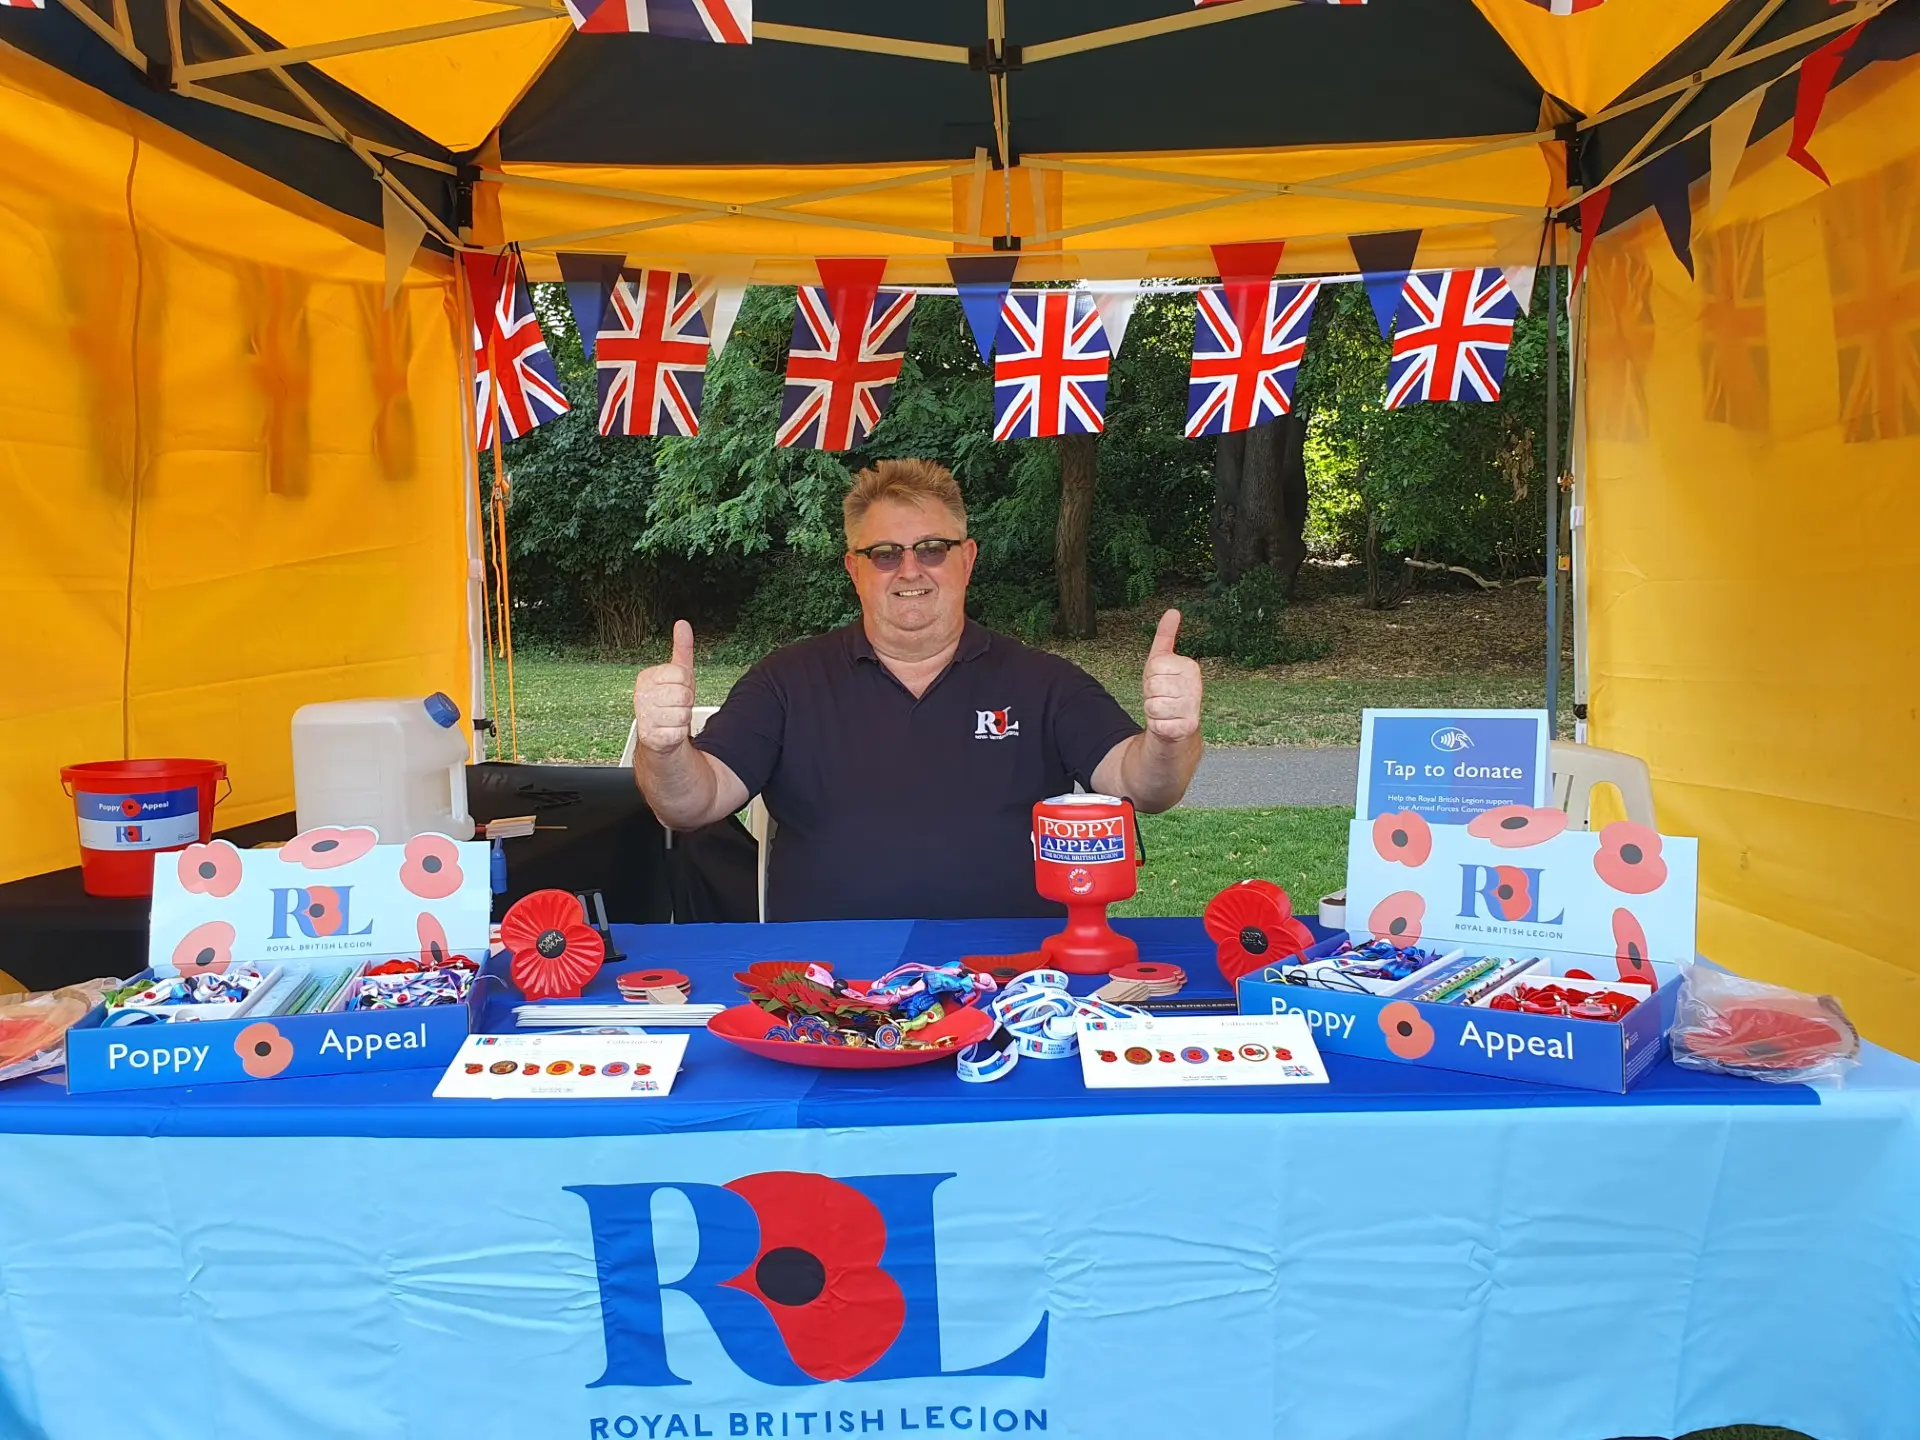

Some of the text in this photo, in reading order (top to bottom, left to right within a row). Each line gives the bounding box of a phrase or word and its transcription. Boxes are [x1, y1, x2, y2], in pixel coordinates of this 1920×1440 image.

[1383, 760, 1523, 780] Tap to donate
[98, 801, 169, 812] Poppy Appeal
[1388, 794, 1404, 803] Help
[1418, 795, 1437, 804] Royal
[1438, 796, 1460, 804] British
[1462, 797, 1484, 806] Legion
[1411, 804, 1434, 812] Armed
[1044, 820, 1117, 838] POPPY
[1044, 838, 1119, 852] APPEAL
[1053, 852, 1071, 860] ROYAL
[1097, 852, 1118, 860] LEGION
[1070, 868, 1088, 880] POPPY
[1072, 882, 1092, 893] APPEAL
[1454, 923, 1563, 940] ROYAL BRITISH LEGION
[300, 943, 336, 951] BRITISH
[338, 941, 372, 949] LEGION
[538, 931, 557, 950] POPPY
[1459, 1020, 1574, 1061] Appeal
[108, 1023, 427, 1075] Poppy Appeal
[590, 1405, 1048, 1440] ROYAL BRITISH LEGION
